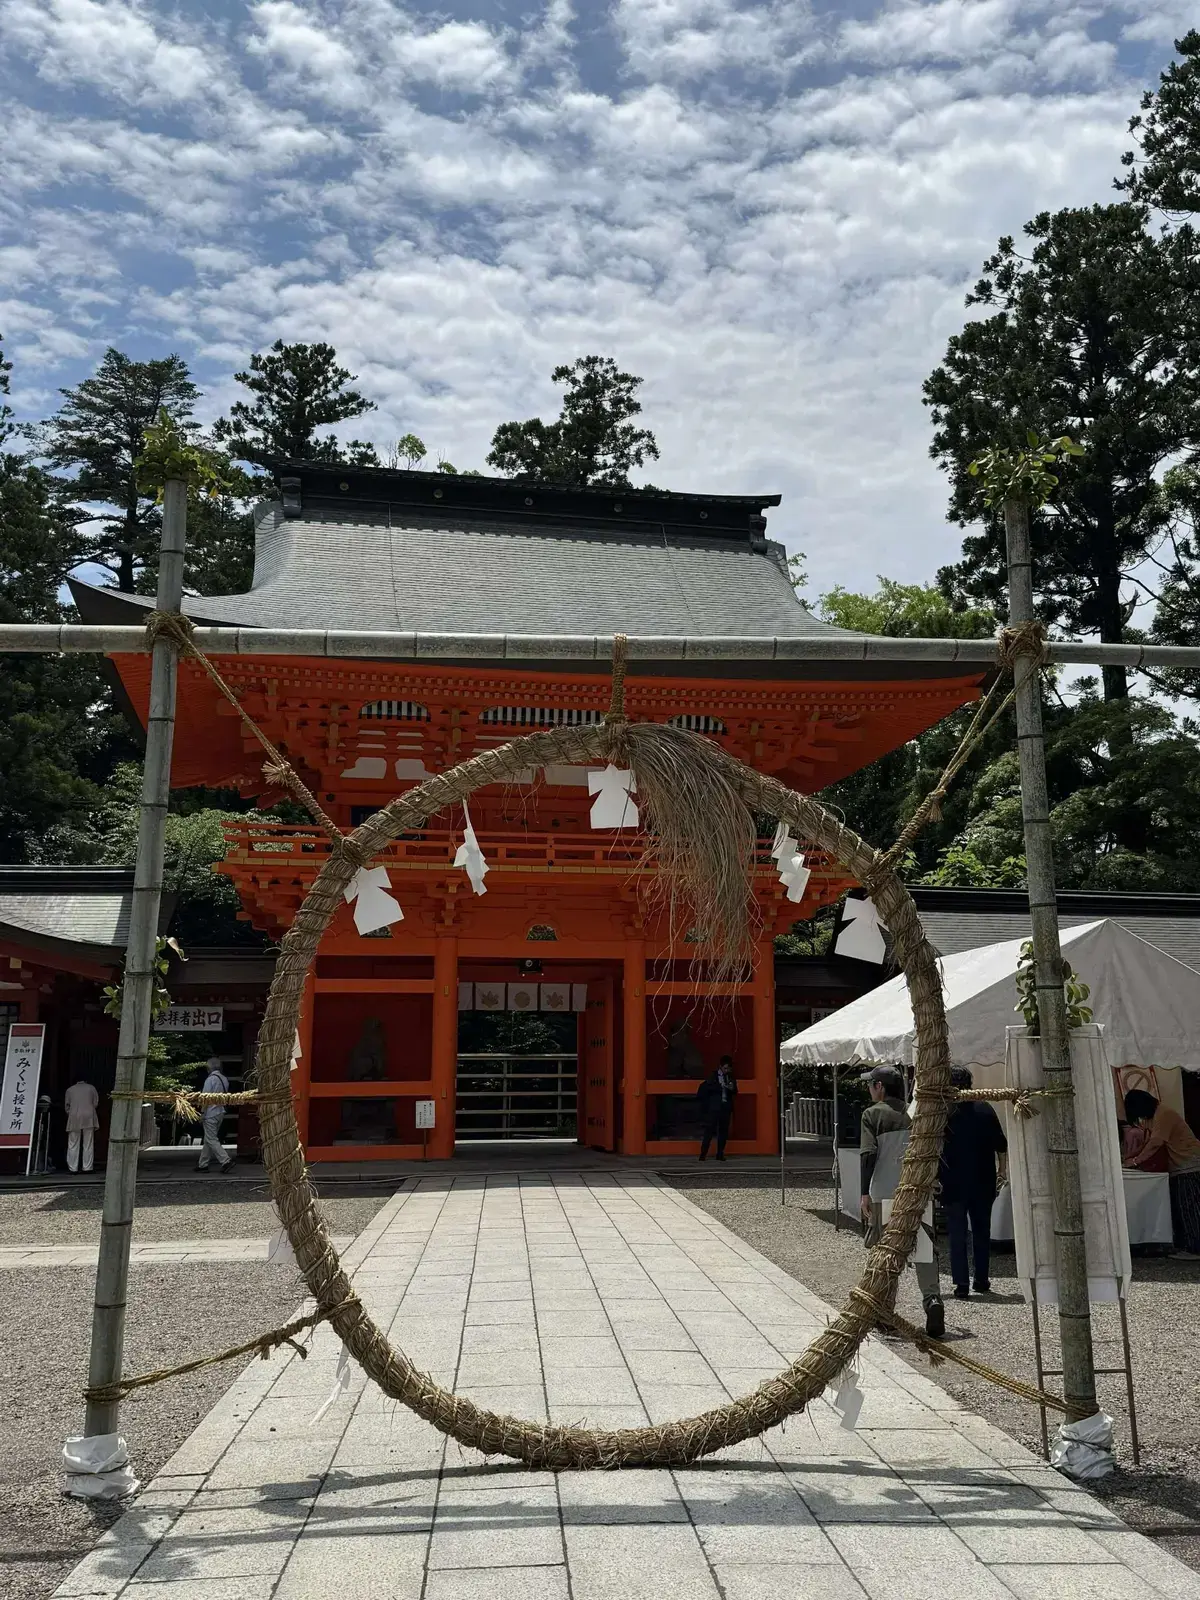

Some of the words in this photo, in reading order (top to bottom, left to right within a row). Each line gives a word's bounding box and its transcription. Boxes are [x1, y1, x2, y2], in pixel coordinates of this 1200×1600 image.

[156, 1009, 222, 1027] 参拝者出口
[9, 1057, 31, 1130] みくじ授与所
